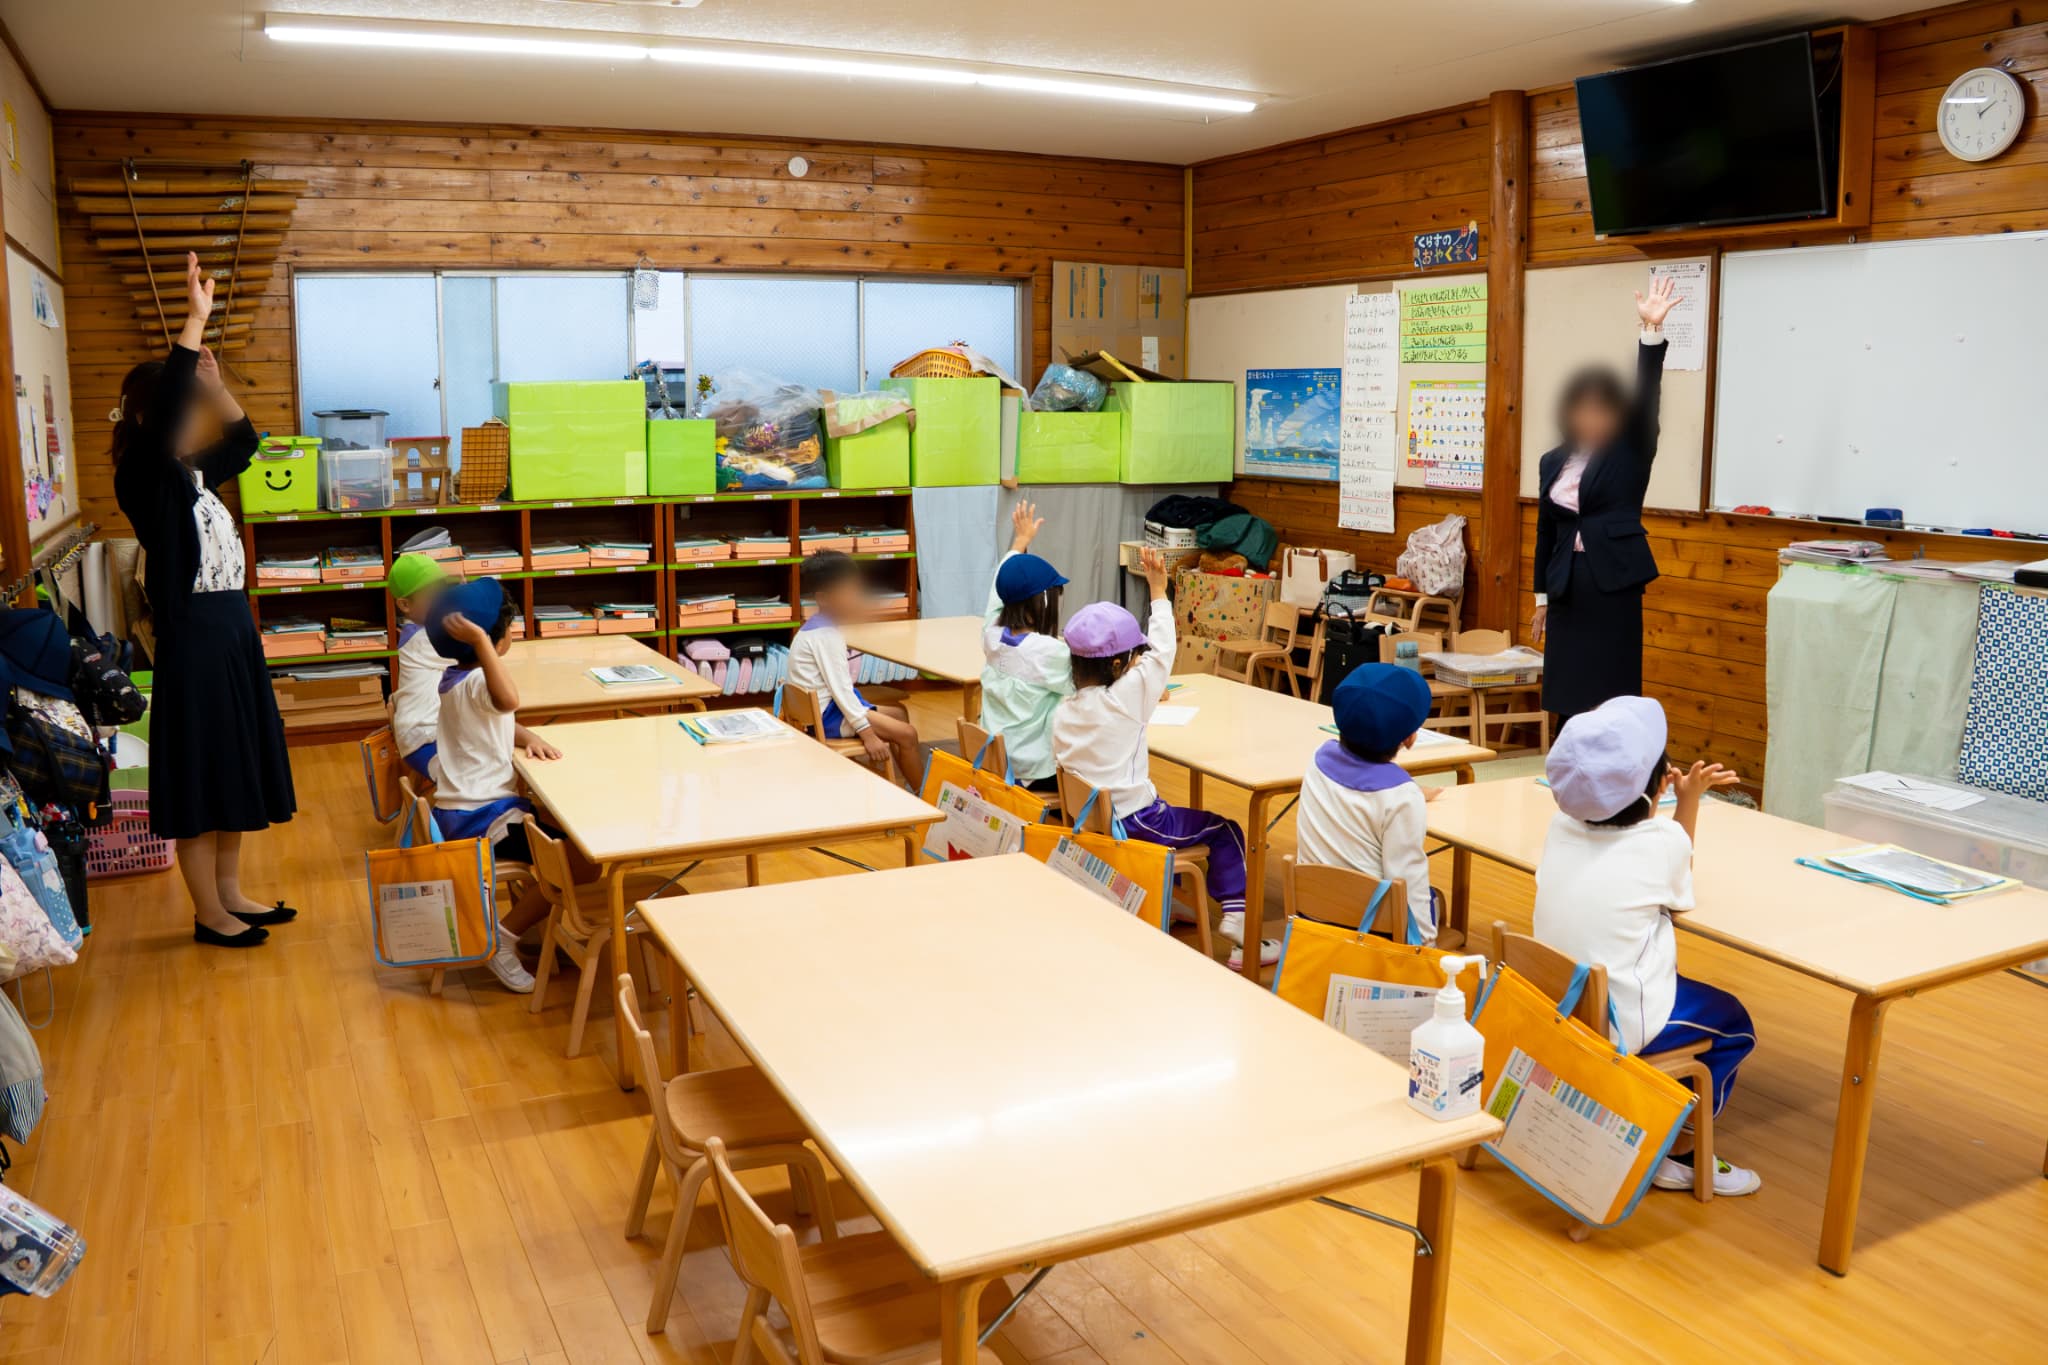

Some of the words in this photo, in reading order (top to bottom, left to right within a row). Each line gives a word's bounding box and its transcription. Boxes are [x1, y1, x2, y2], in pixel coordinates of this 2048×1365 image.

[1977, 80, 1985, 93] 12
[2001, 90, 2008, 102] 2
[1977, 137, 1983, 152] 6
[1991, 132, 1997, 144] 5
[1418, 233, 1452, 248] くらすの
